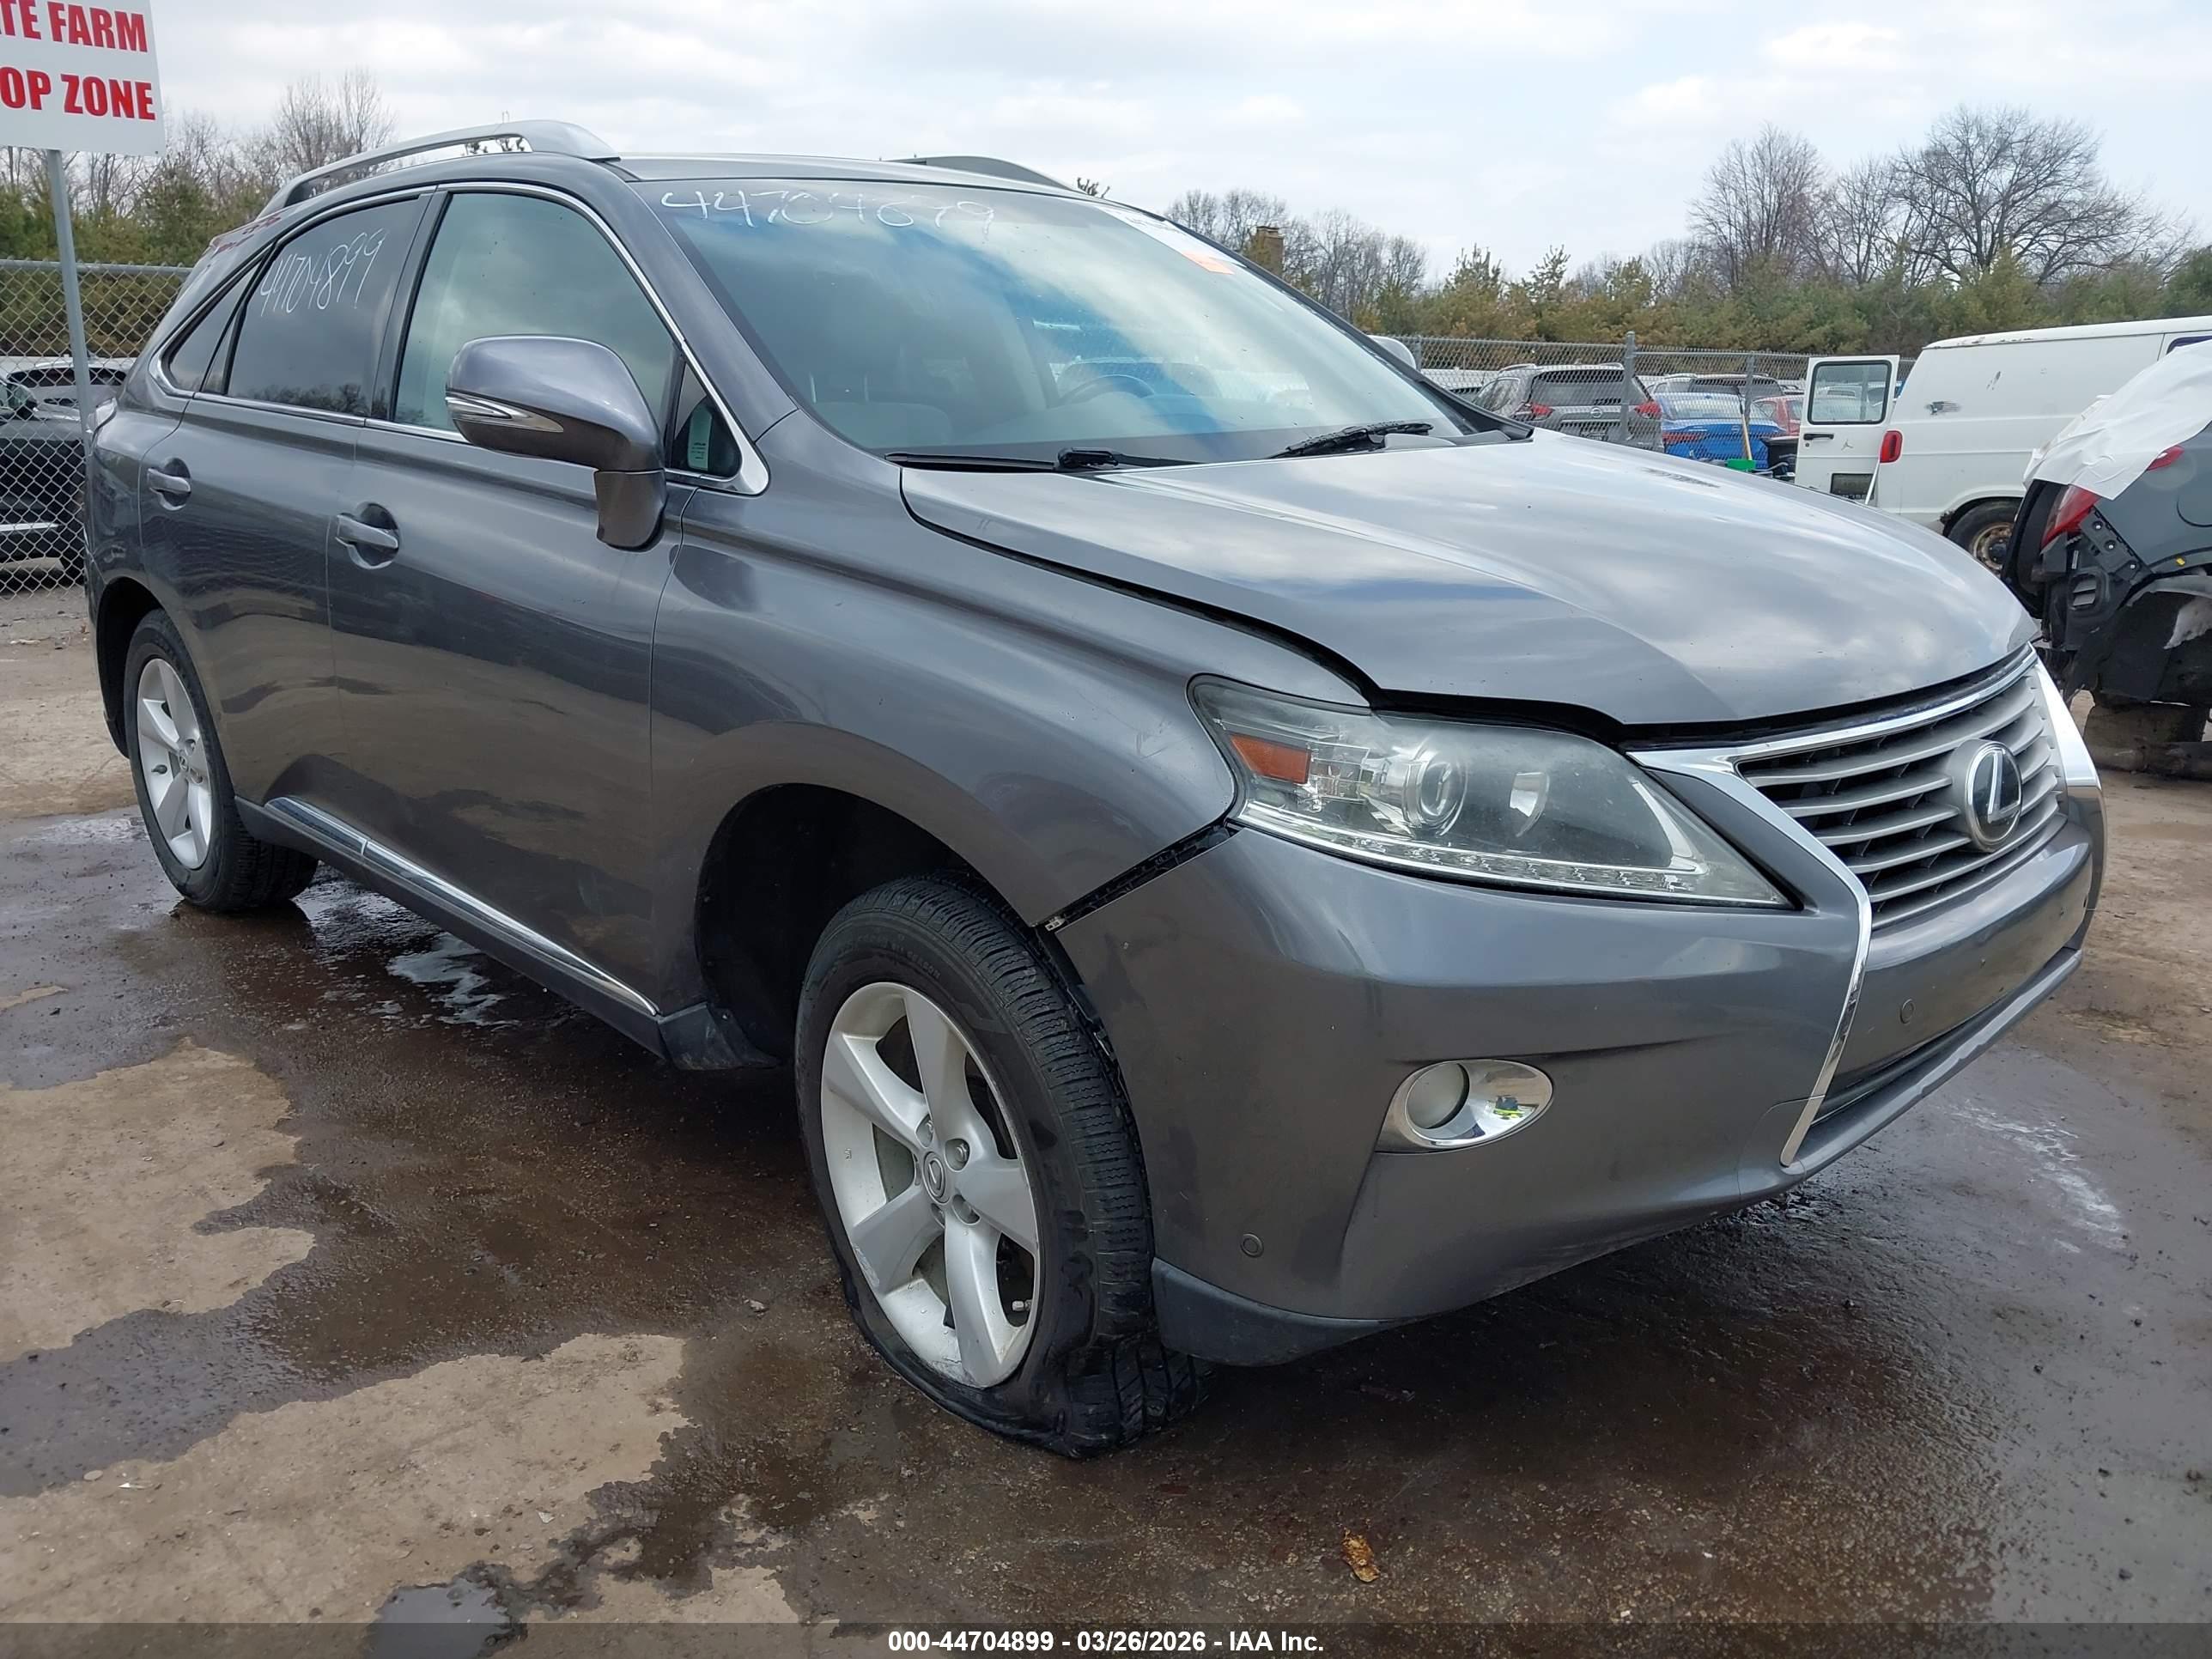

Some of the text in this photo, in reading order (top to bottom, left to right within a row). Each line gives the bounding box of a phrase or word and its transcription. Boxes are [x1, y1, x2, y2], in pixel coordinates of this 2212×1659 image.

[0, 0, 148, 52] TE FARM
[60, 74, 155, 120] ZONE
